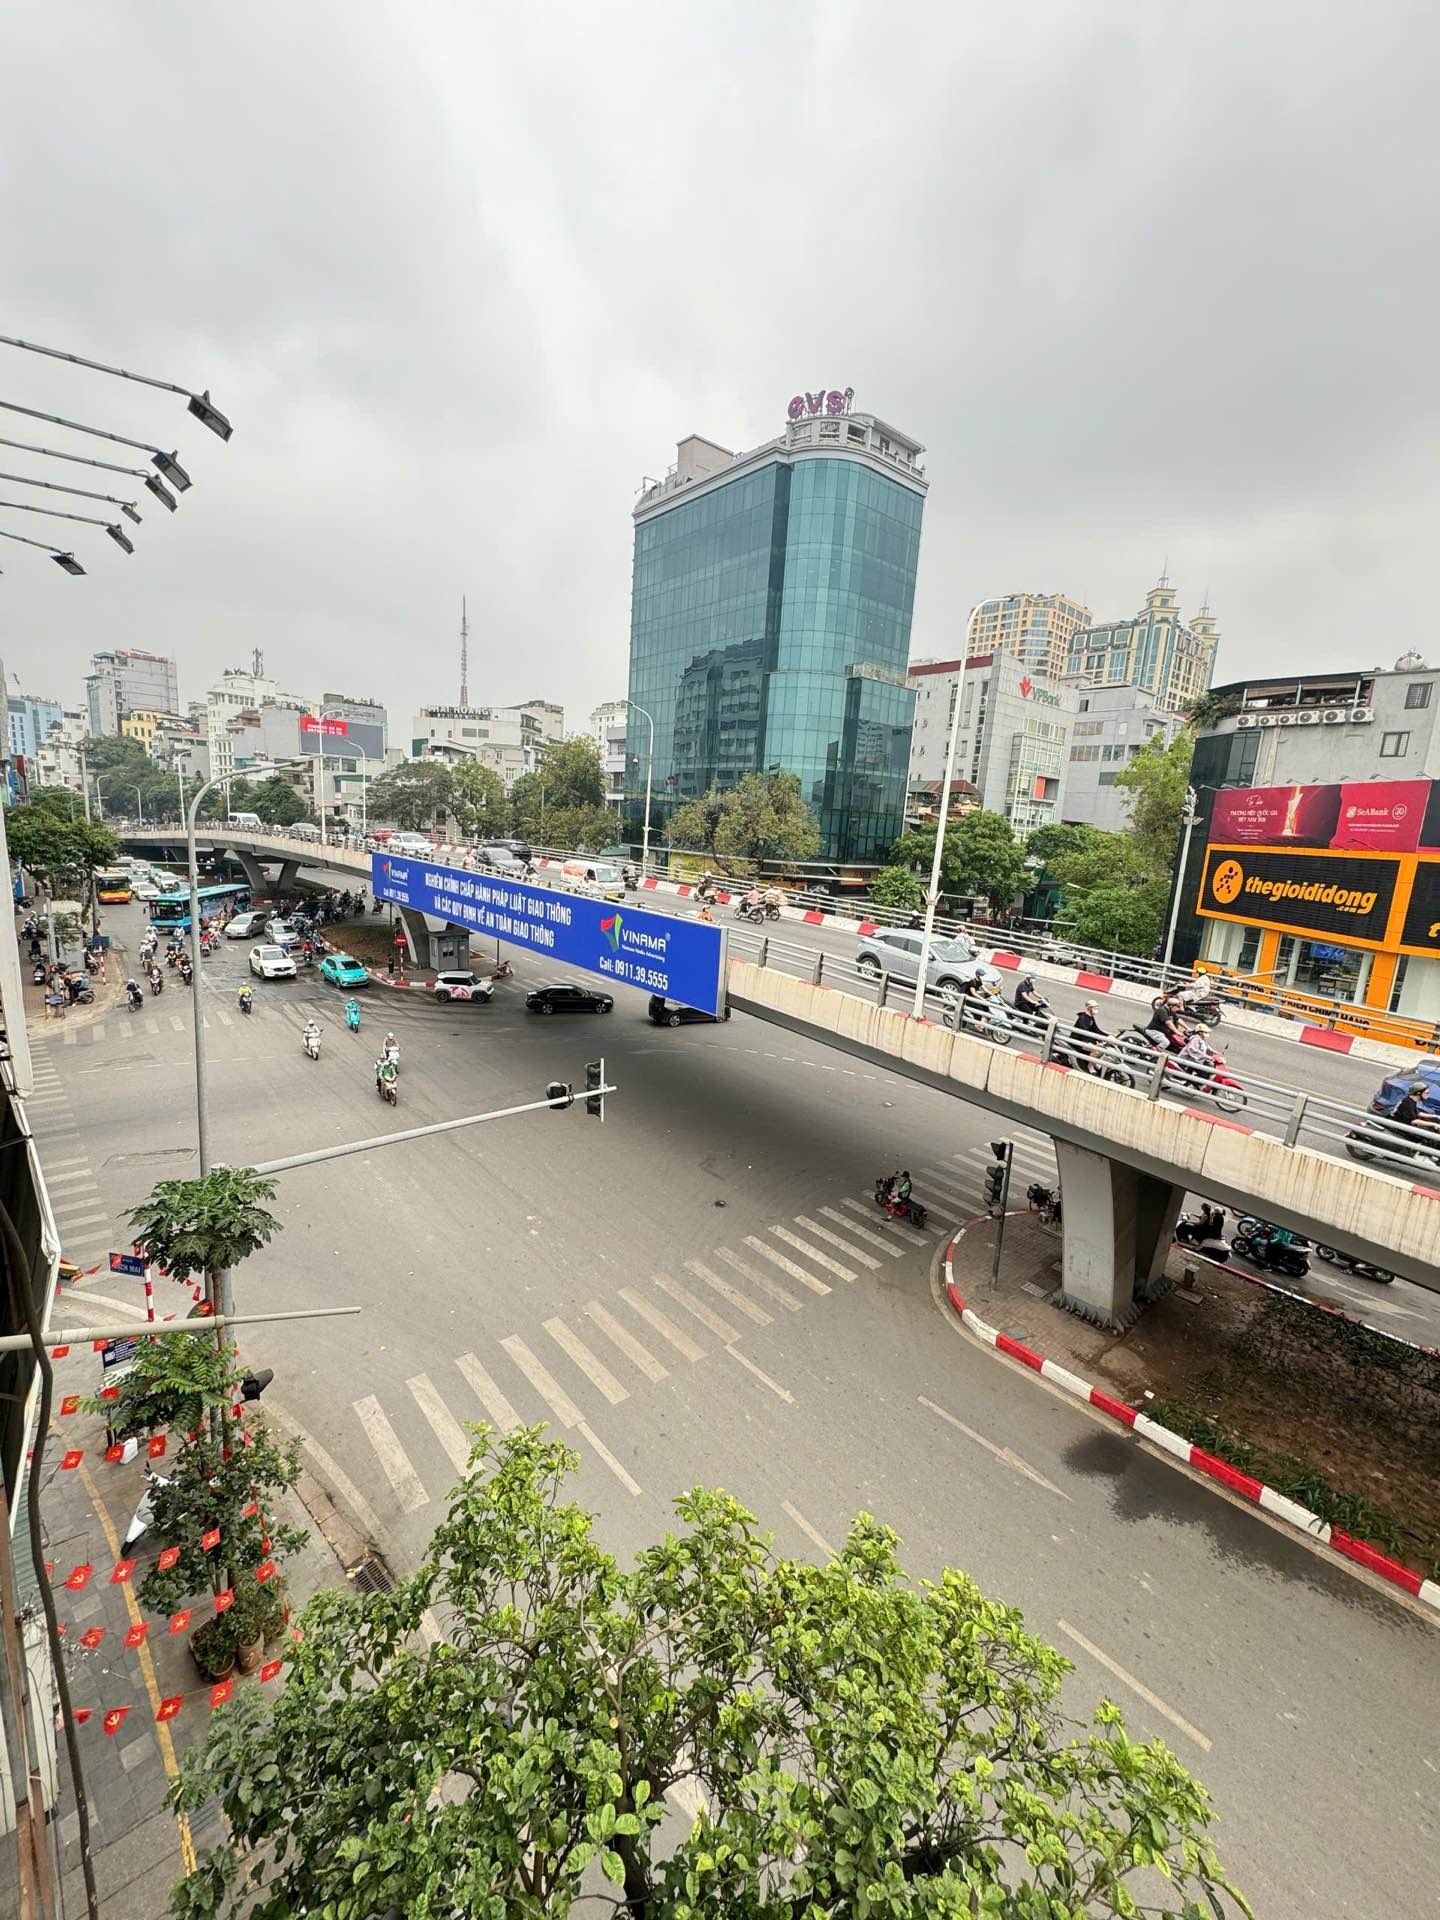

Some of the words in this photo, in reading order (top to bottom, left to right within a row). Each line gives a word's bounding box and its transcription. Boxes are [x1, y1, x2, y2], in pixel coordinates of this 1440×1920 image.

[1032, 686, 1062, 708] VPBank
[1356, 807, 1389, 816] SeABank
[459, 879, 475, 898] CHẤP
[475, 883, 491, 903] HÀNH
[492, 888, 508, 908] PHÁP
[509, 892, 526, 916] LUẬT
[527, 898, 544, 918] GIAO
[546, 902, 572, 926] THÔNG
[1244, 875, 1377, 915] thegioididong
[434, 894, 441, 910] VÀ
[441, 896, 452, 914] CÁC
[452, 901, 463, 917] QUY
[486, 911, 494, 928] AN
[496, 912, 512, 934] TOÀN
[513, 919, 529, 940] GIAO
[530, 924, 555, 948] THÔNG
[622, 929, 666, 952] VINAMA
[599, 956, 614, 973] Call:
[615, 959, 669, 991] 0911.39.5555
